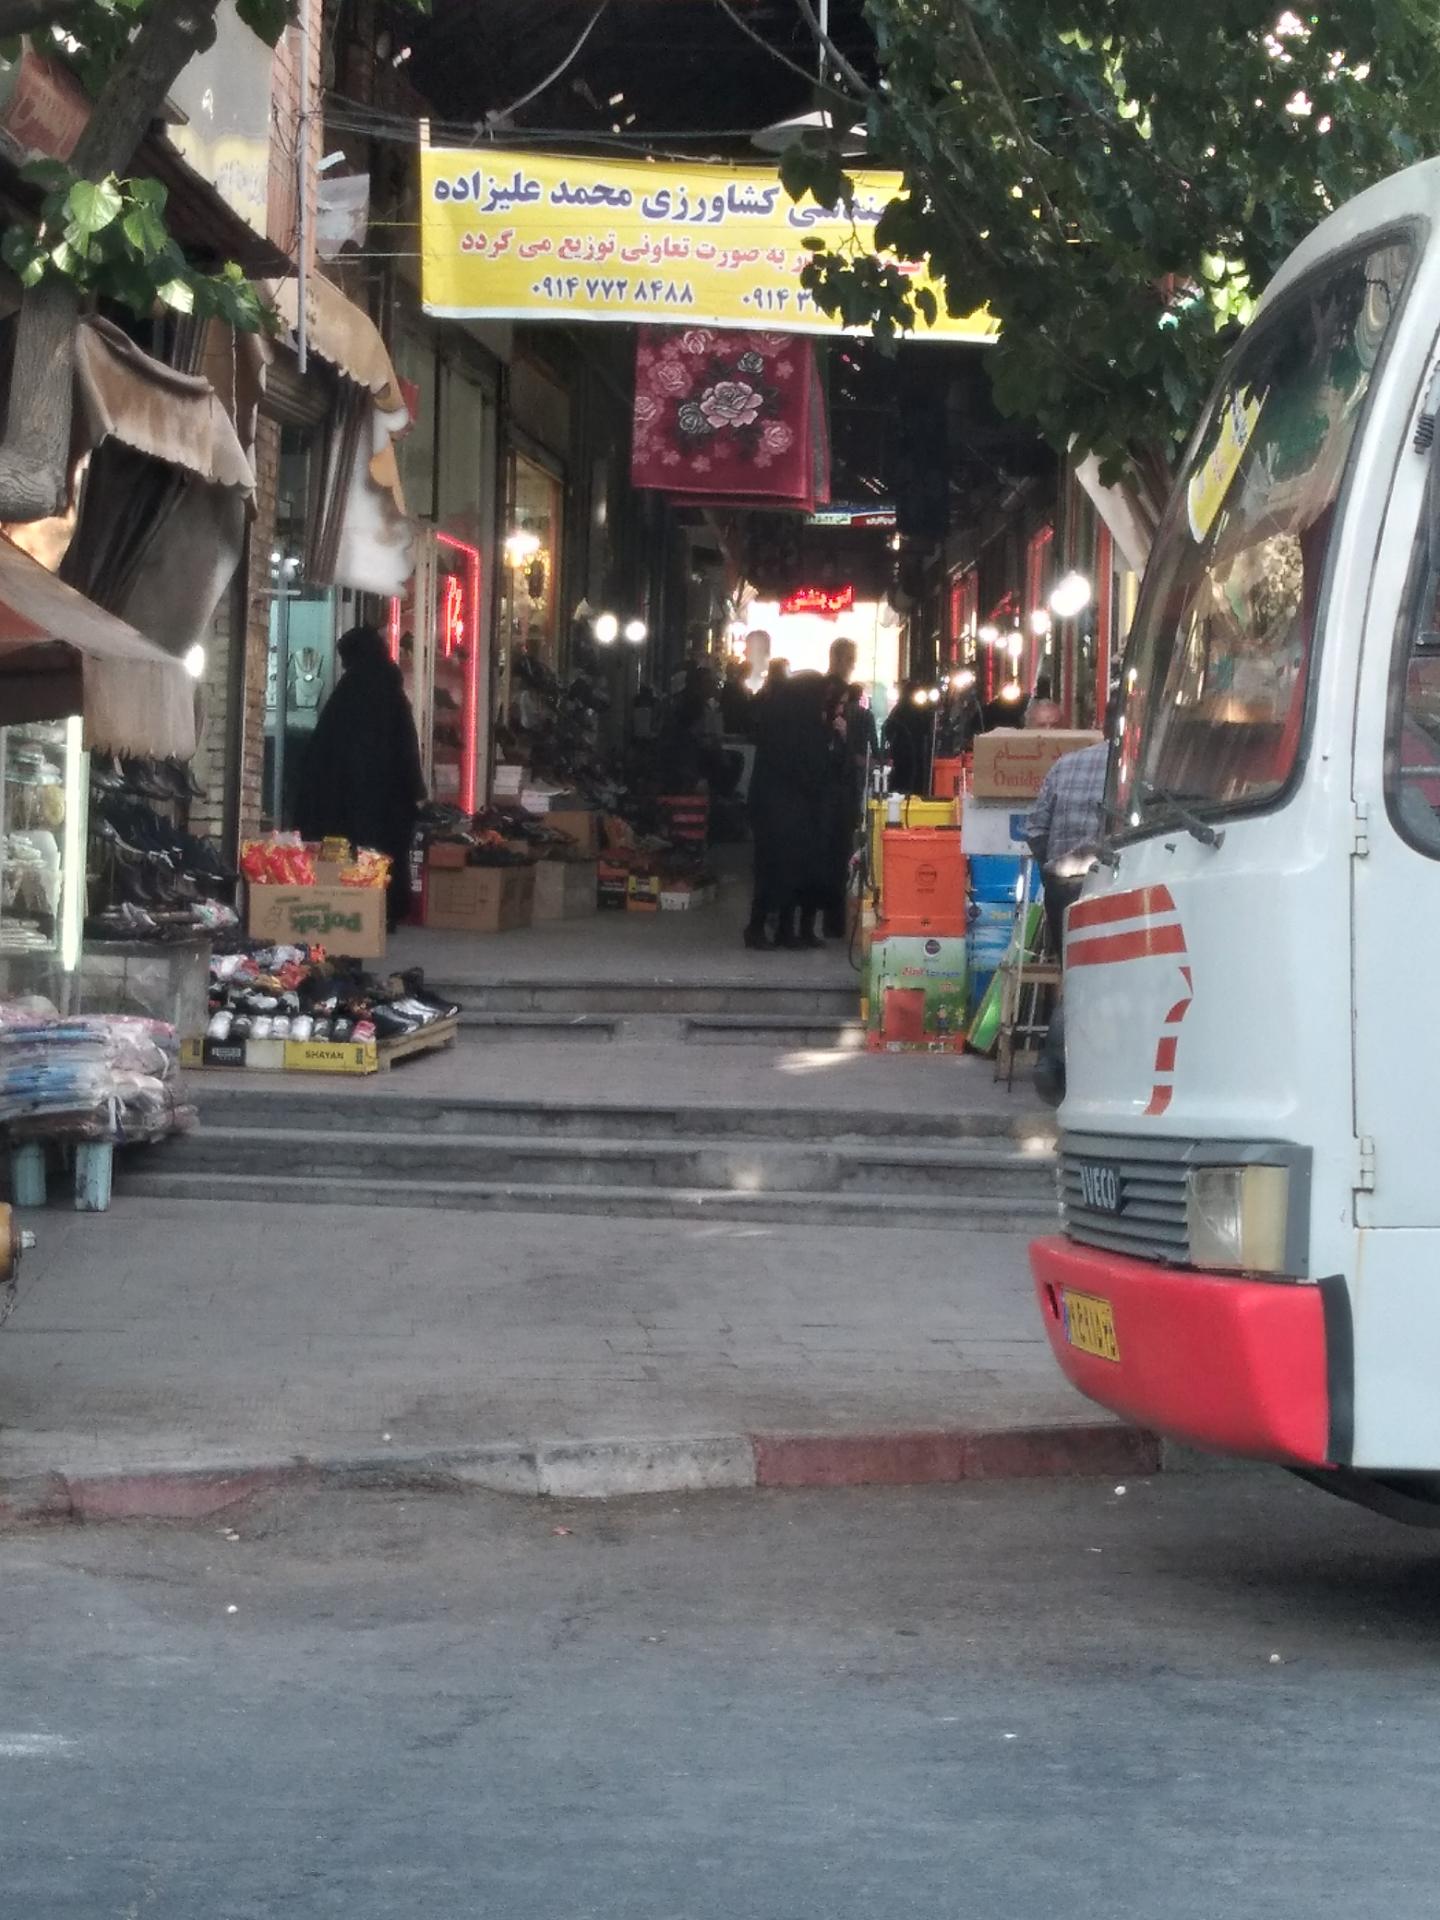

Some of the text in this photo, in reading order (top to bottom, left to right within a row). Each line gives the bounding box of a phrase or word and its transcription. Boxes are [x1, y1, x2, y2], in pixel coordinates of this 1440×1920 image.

[434, 171, 540, 212] علیزاده
[551, 181, 632, 206] محمد
[642, 184, 780, 223] کشاورزی
[461, 229, 514, 258] گردد
[519, 238, 551, 258] می
[558, 233, 615, 260] توزیع
[621, 235, 690, 264] تعاونی
[695, 243, 760, 268] صورت
[766, 247, 786, 270] به
[532, 277, 694, 303] ۰۹۱۴ ۷۷۲ ۸۴۸۸
[743, 288, 789, 310] ۰۹۱۴
[304, 1049, 345, 1060] SHAYAN
[1080, 1165, 1116, 1210] IVECO
